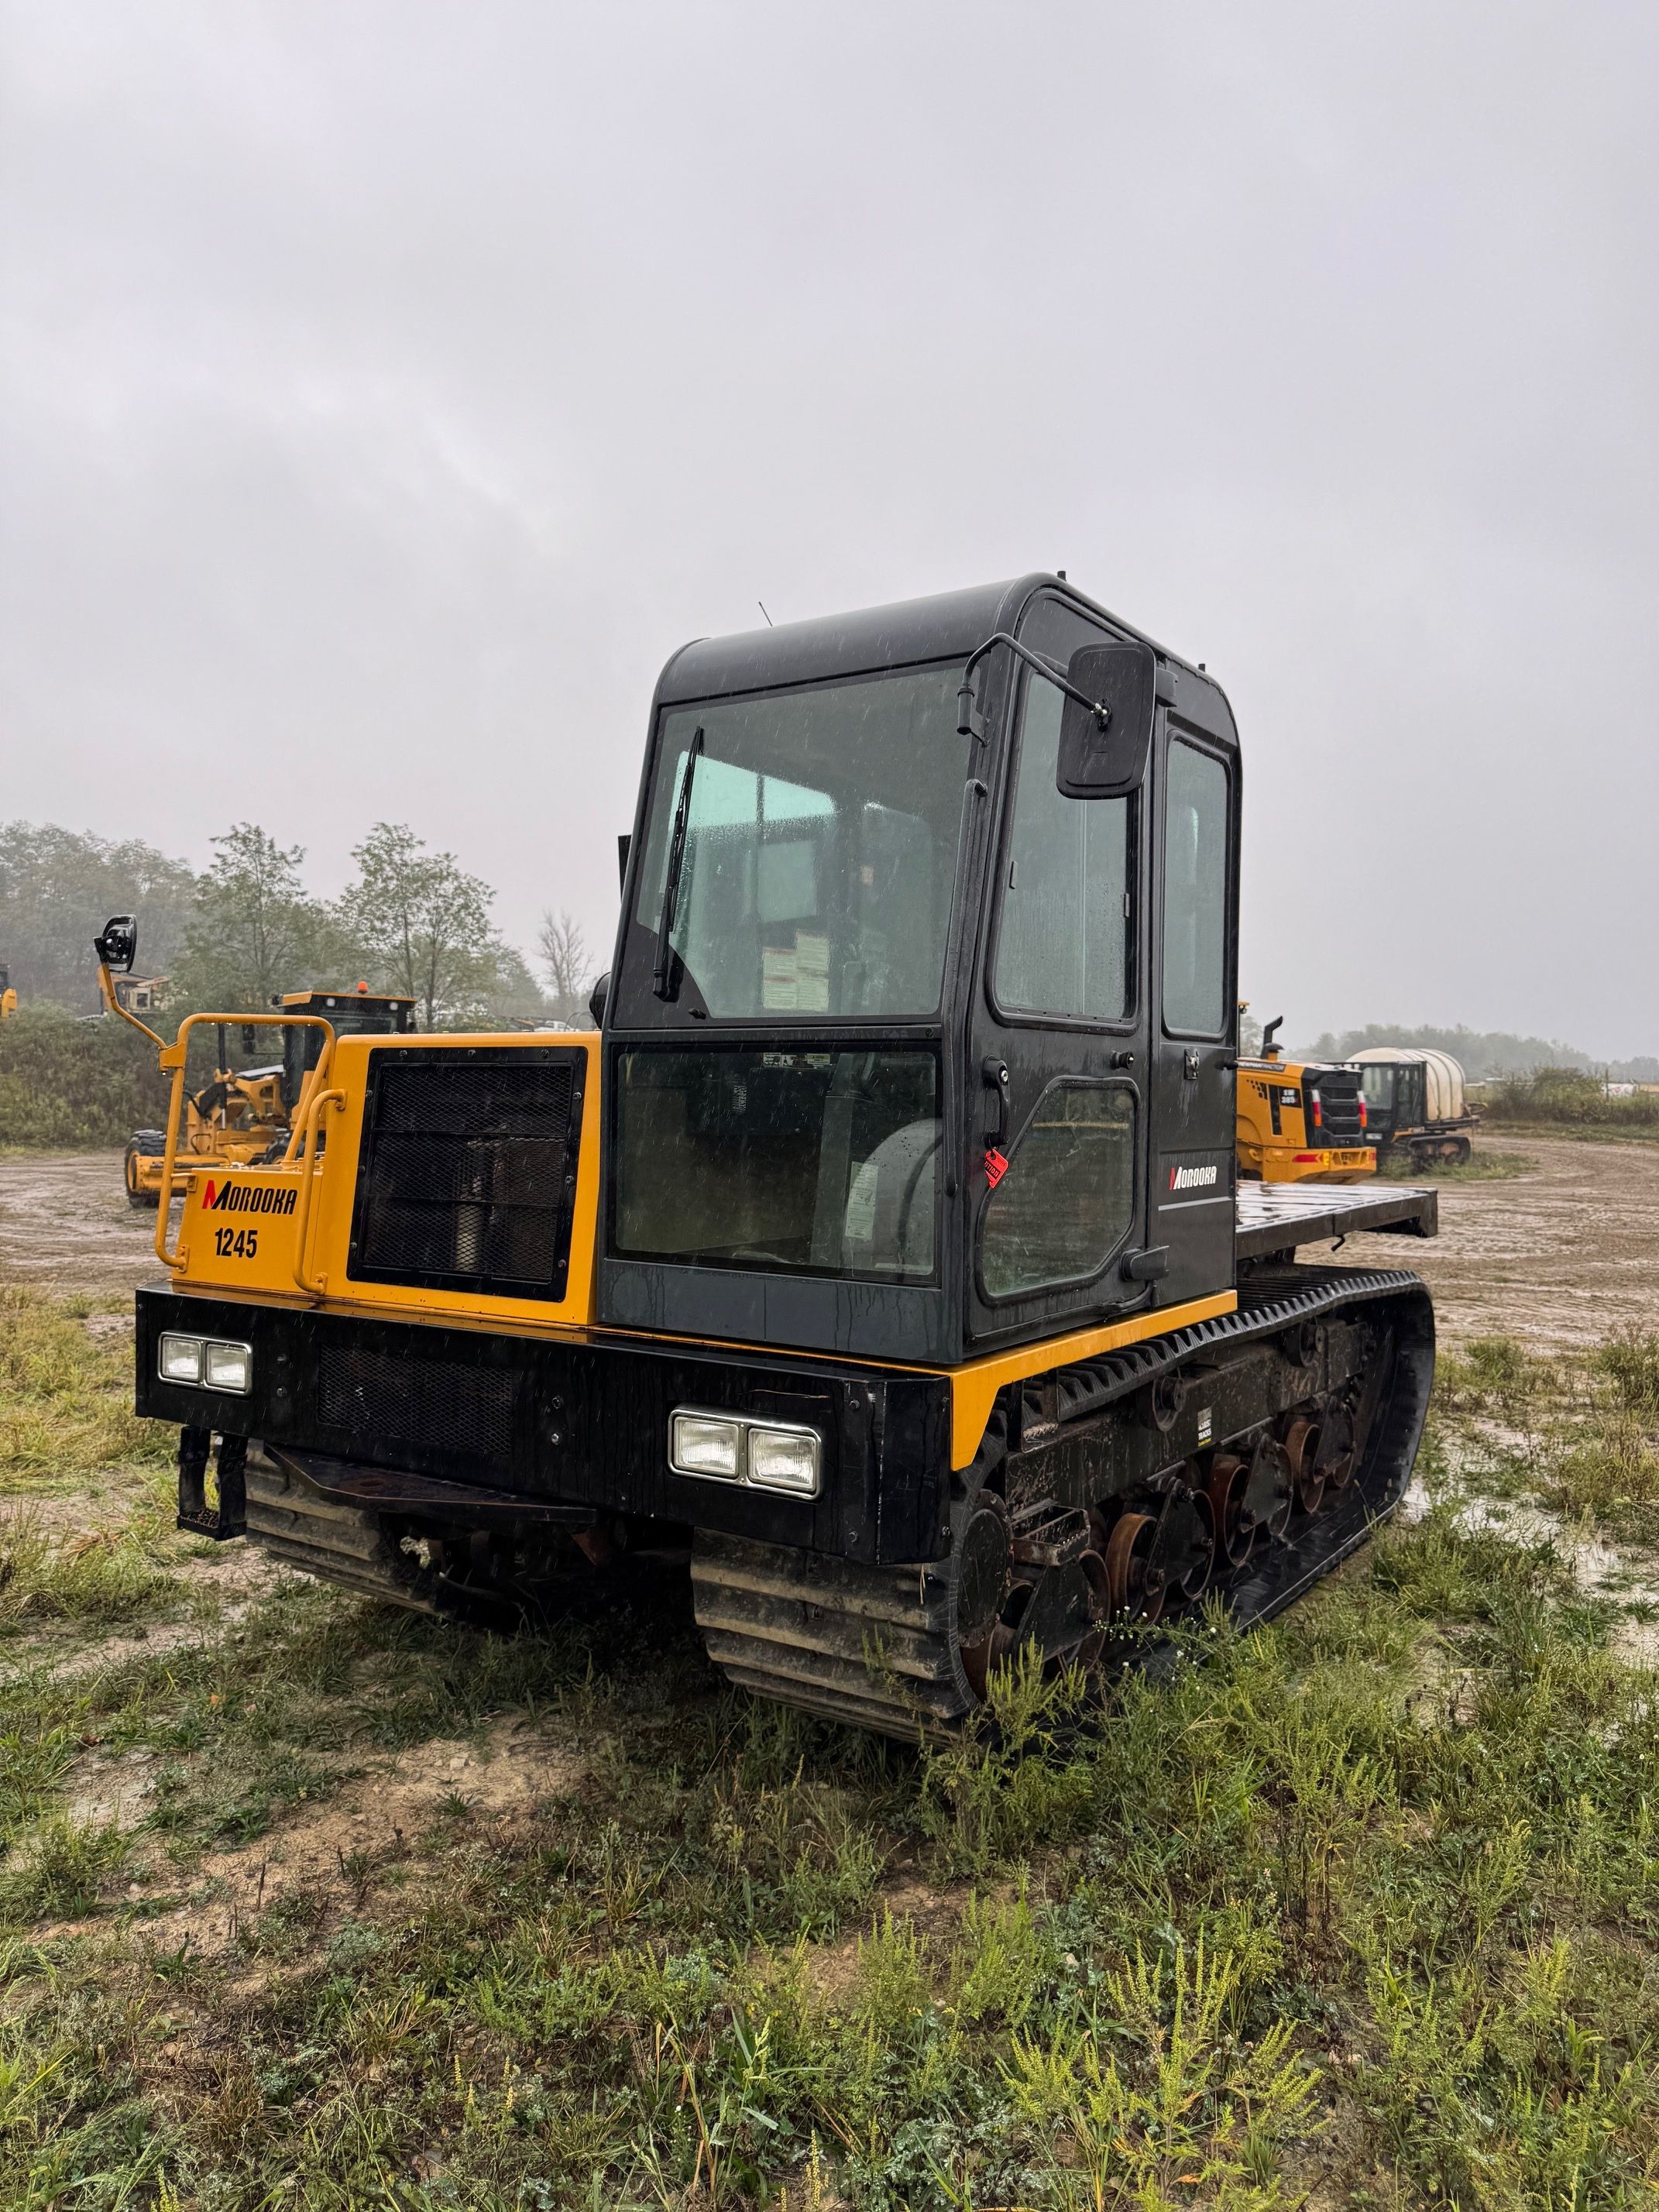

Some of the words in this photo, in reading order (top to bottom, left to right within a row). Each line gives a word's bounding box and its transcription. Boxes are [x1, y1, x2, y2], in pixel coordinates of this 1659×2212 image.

[1169, 1166, 1218, 1190] MOROOKA
[201, 1180, 298, 1215] MOROOKA
[215, 1228, 259, 1259] 1245
